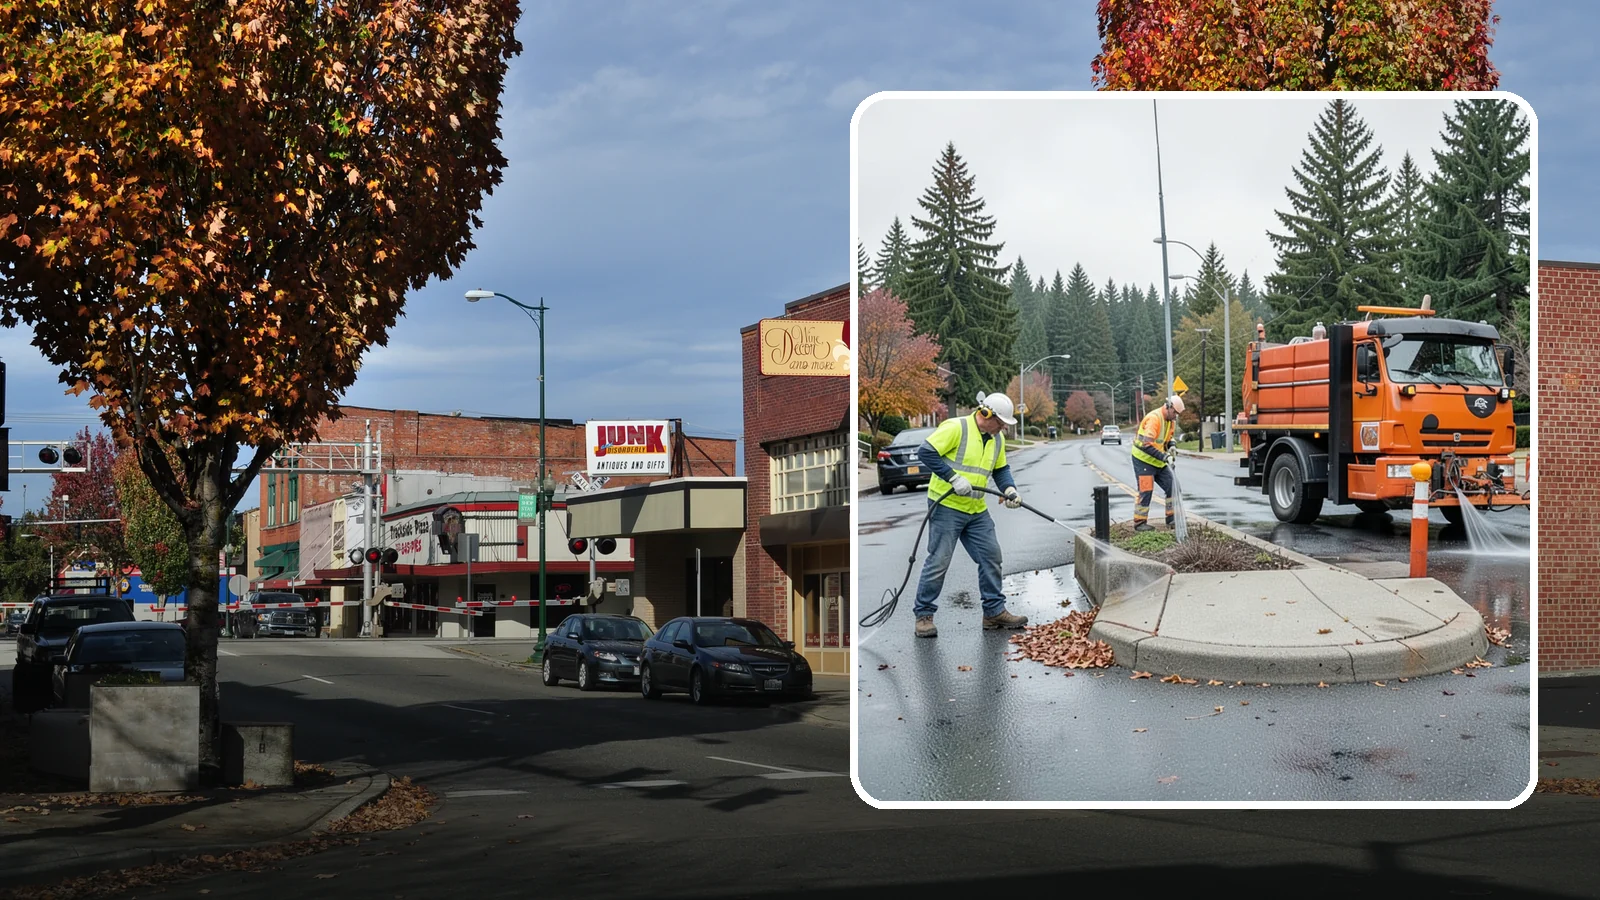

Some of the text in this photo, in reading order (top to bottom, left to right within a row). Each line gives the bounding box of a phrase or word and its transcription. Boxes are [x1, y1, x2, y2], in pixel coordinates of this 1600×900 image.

[596, 425, 665, 457] JUNK
[607, 446, 646, 454] DISORDERLY
[597, 460, 665, 470] ANTIQUES AND GIFTS
[414, 519, 429, 535] Pizza
